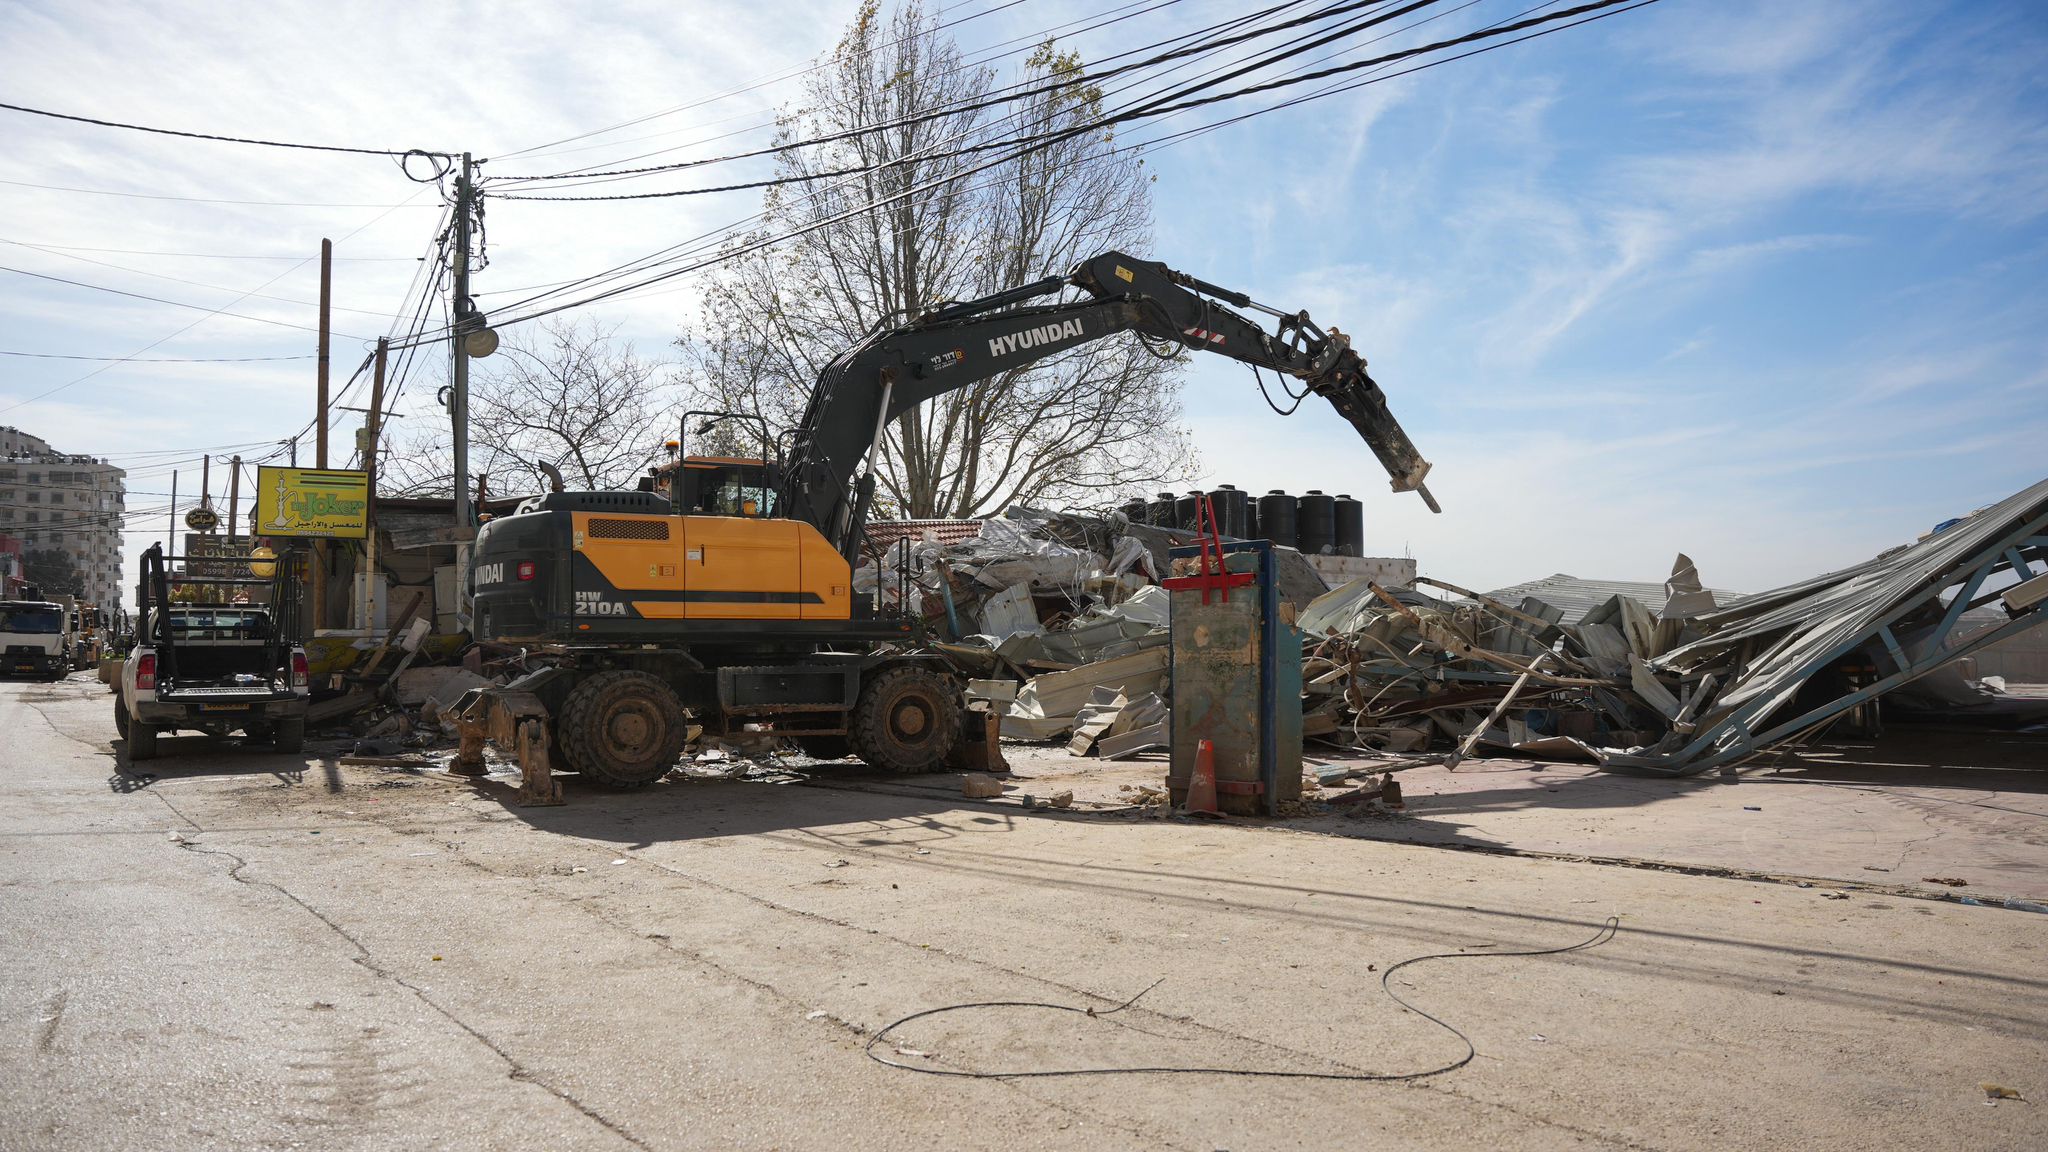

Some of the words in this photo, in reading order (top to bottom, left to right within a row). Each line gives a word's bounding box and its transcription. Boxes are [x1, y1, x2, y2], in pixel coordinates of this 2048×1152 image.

[988, 318, 1084, 357] HYUNDAI
[329, 521, 363, 529] للمعسل
[576, 592, 601, 601] HW
[575, 602, 626, 615] 210A
